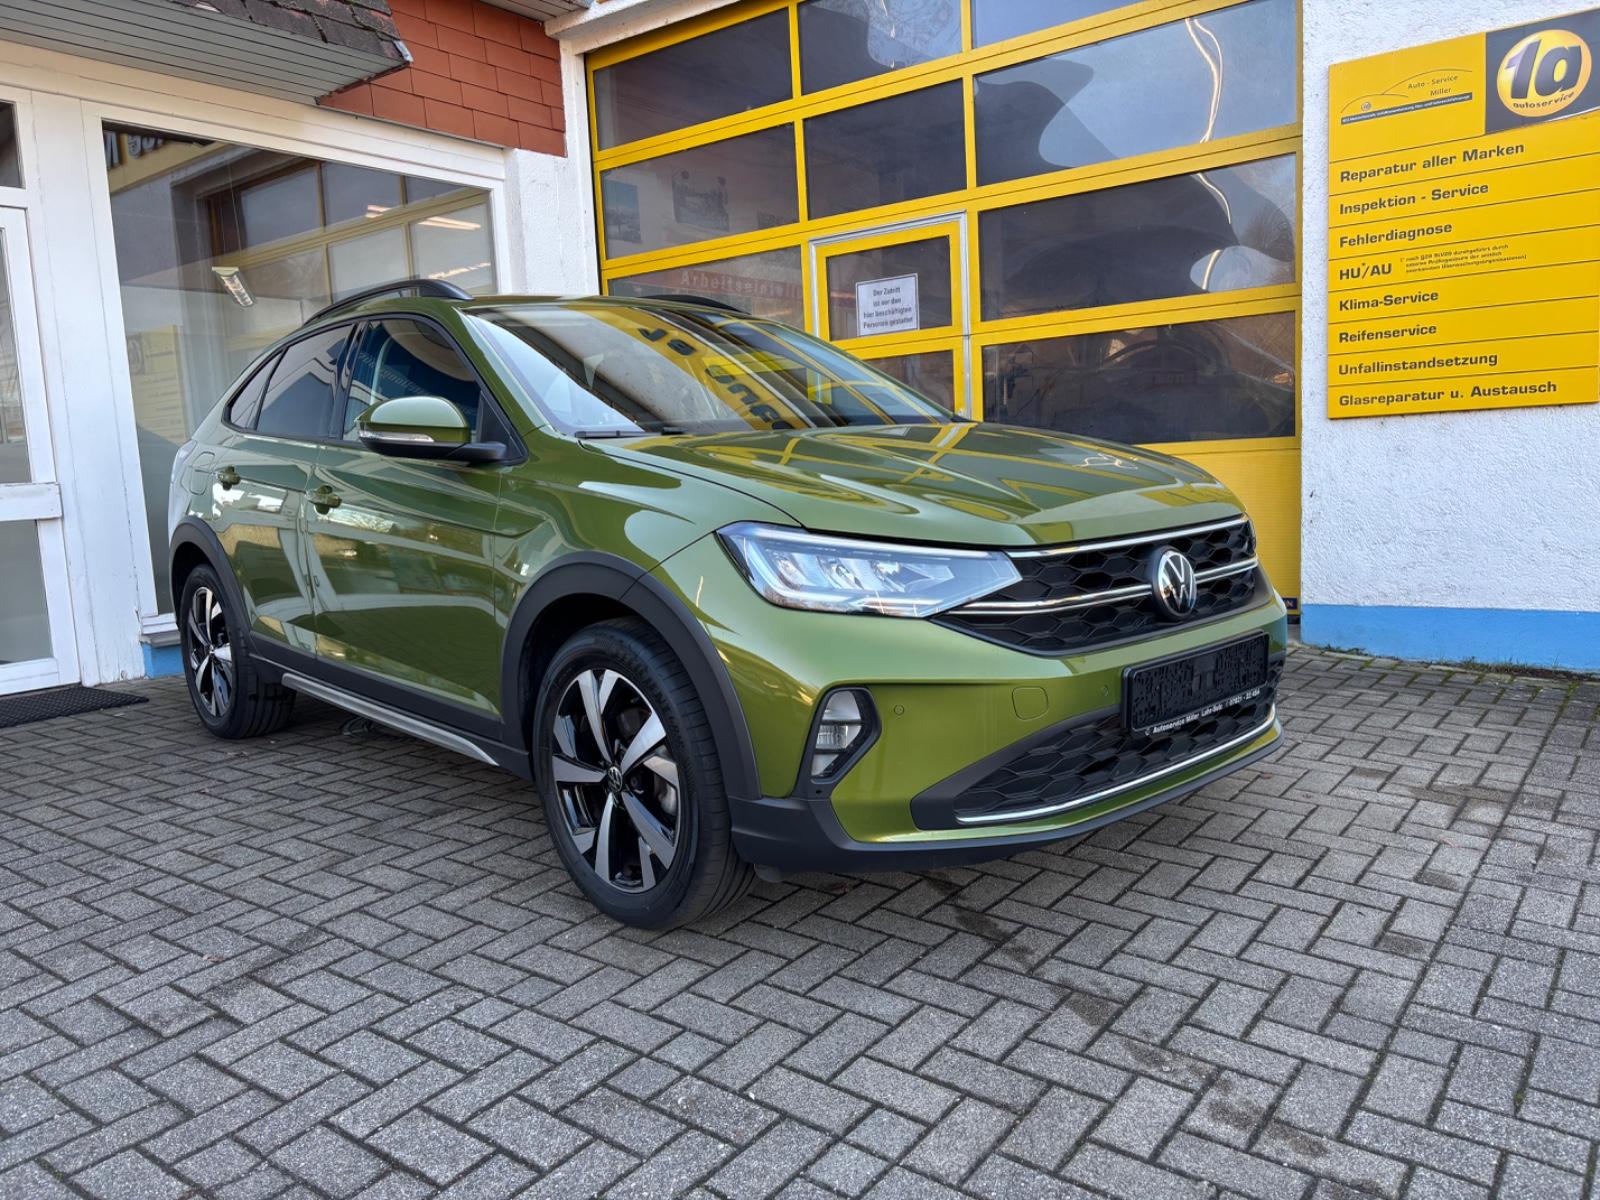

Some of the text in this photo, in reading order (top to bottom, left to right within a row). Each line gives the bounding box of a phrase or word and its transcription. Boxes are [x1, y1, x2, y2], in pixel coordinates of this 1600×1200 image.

[1408, 81, 1426, 90] Auto
[1431, 75, 1459, 86] Service
[1430, 87, 1451, 96] Miller
[1513, 91, 1575, 109] autoservice
[1340, 143, 1525, 182] Reparatur aller Marken
[1340, 195, 1416, 215] Inspektion
[1431, 183, 1489, 200] Service
[1340, 223, 1453, 248] Fehlerdiagnose
[883, 287, 901, 295] Zutritt
[1339, 291, 1439, 311] Klima-Service
[863, 306, 912, 319] hier beschäftigten
[863, 320, 889, 328] Personen
[1339, 324, 1437, 343] Reifenservice
[1339, 354, 1498, 375] Unfallinstandsetzung
[1339, 381, 1557, 407] Glasreparatur u. Austausch
[1186, 713, 1200, 723] Miller
